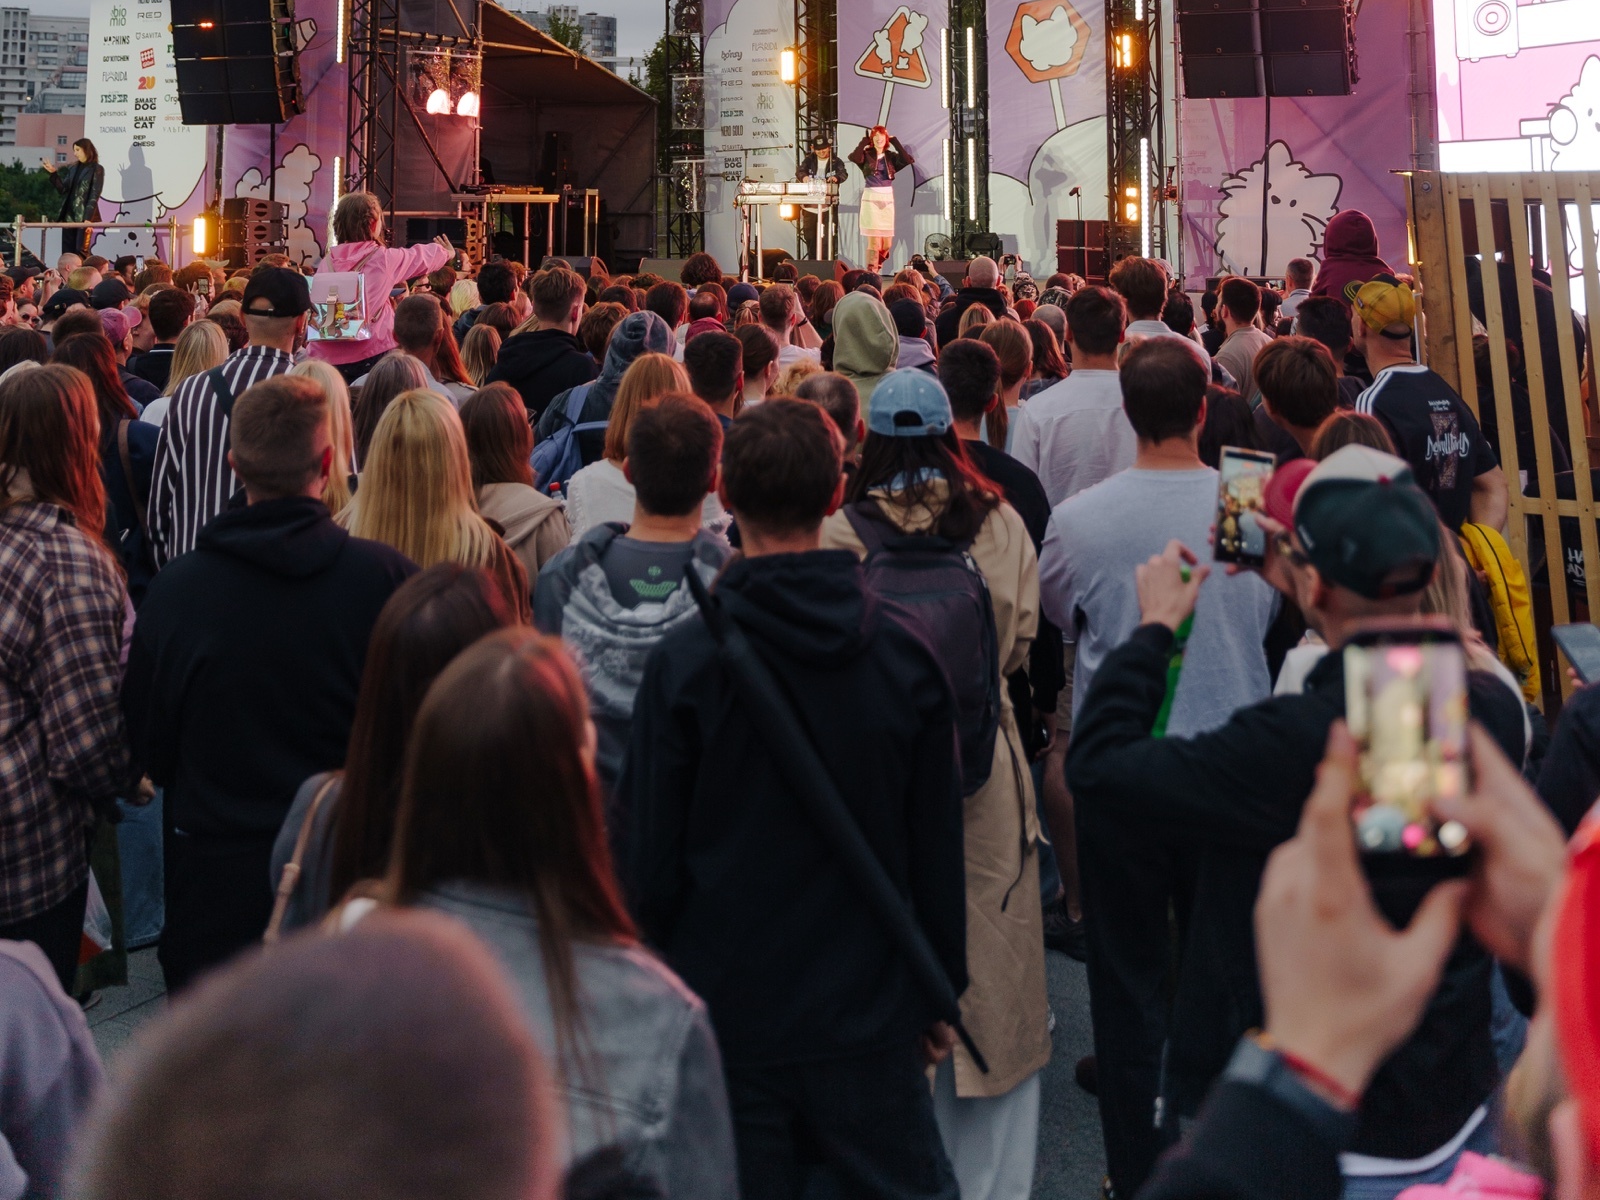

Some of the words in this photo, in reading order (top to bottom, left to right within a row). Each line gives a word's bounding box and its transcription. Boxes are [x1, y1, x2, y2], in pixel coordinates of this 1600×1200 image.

[137, 11, 162, 19] RED
[110, 17, 127, 27] mio
[135, 103, 157, 111] DOG
[100, 110, 127, 118] petsmack
